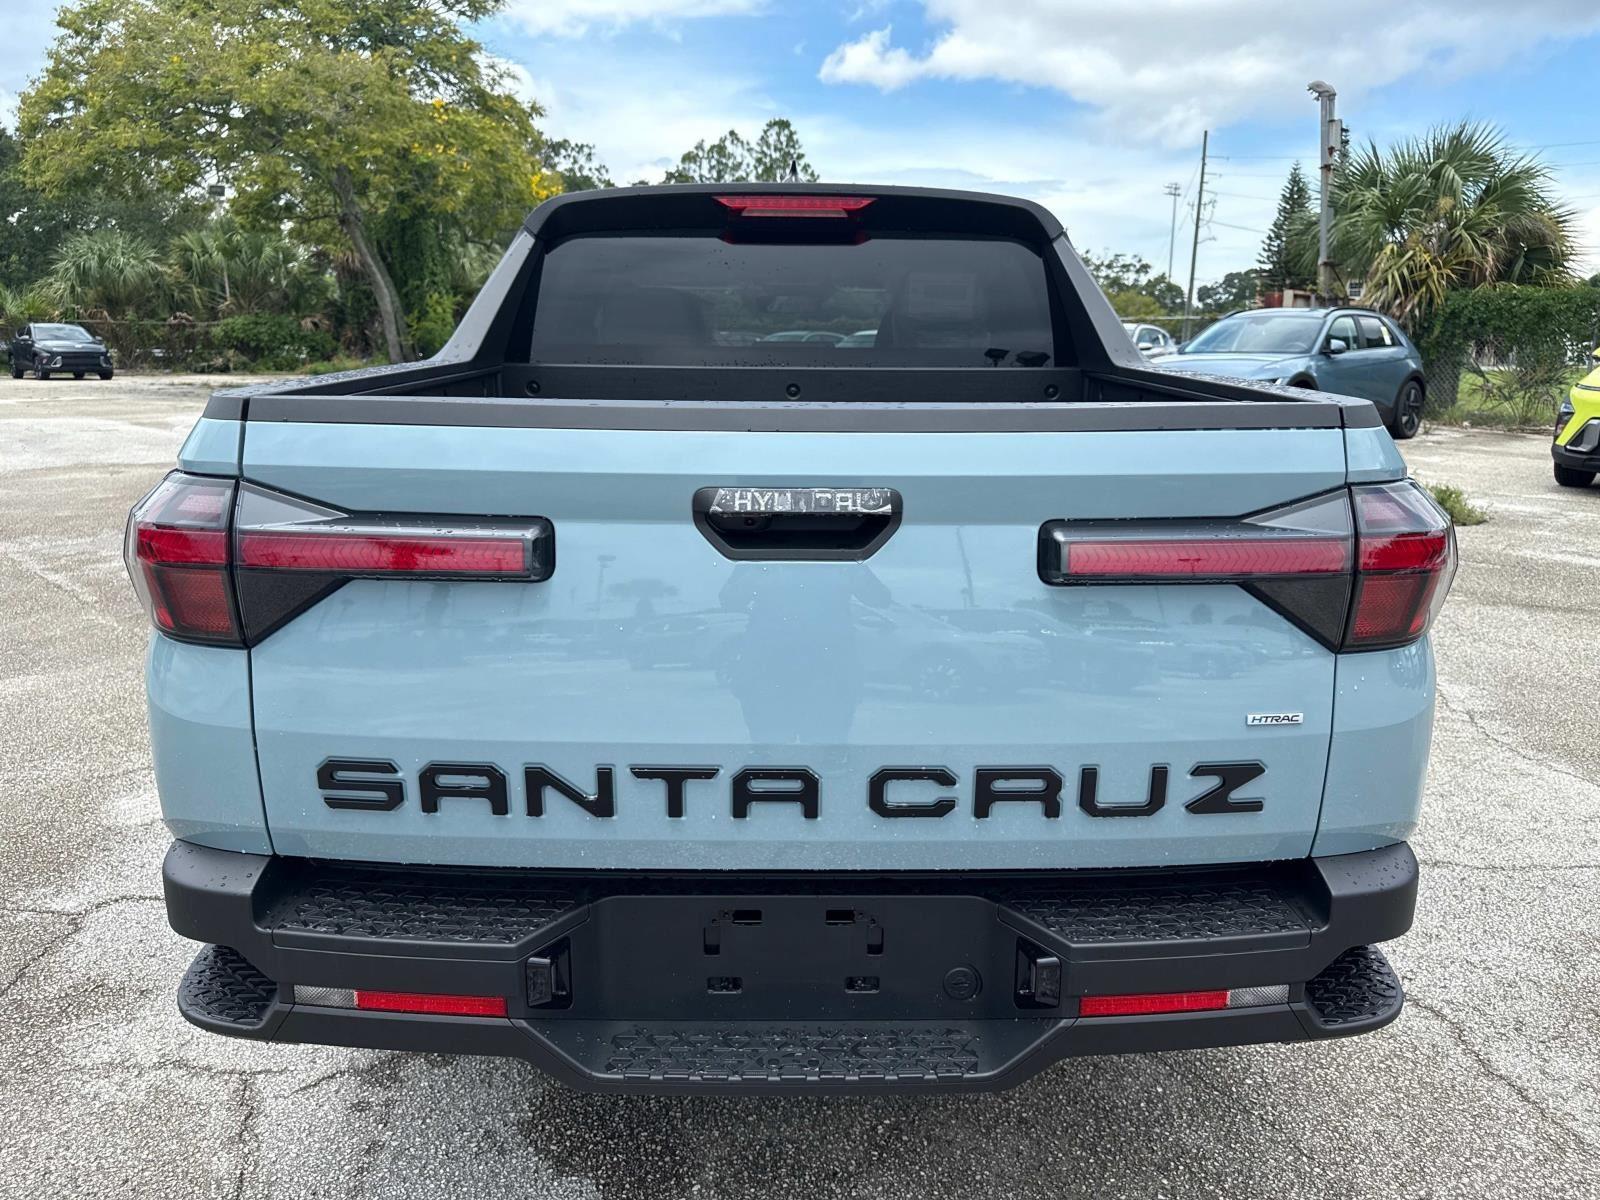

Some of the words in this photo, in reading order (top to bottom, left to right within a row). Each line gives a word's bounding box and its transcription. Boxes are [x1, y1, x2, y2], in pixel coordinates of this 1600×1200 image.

[1251, 714, 1300, 723] HTRAC
[316, 757, 821, 819] SANTA
[868, 760, 1266, 818] CRUZ
